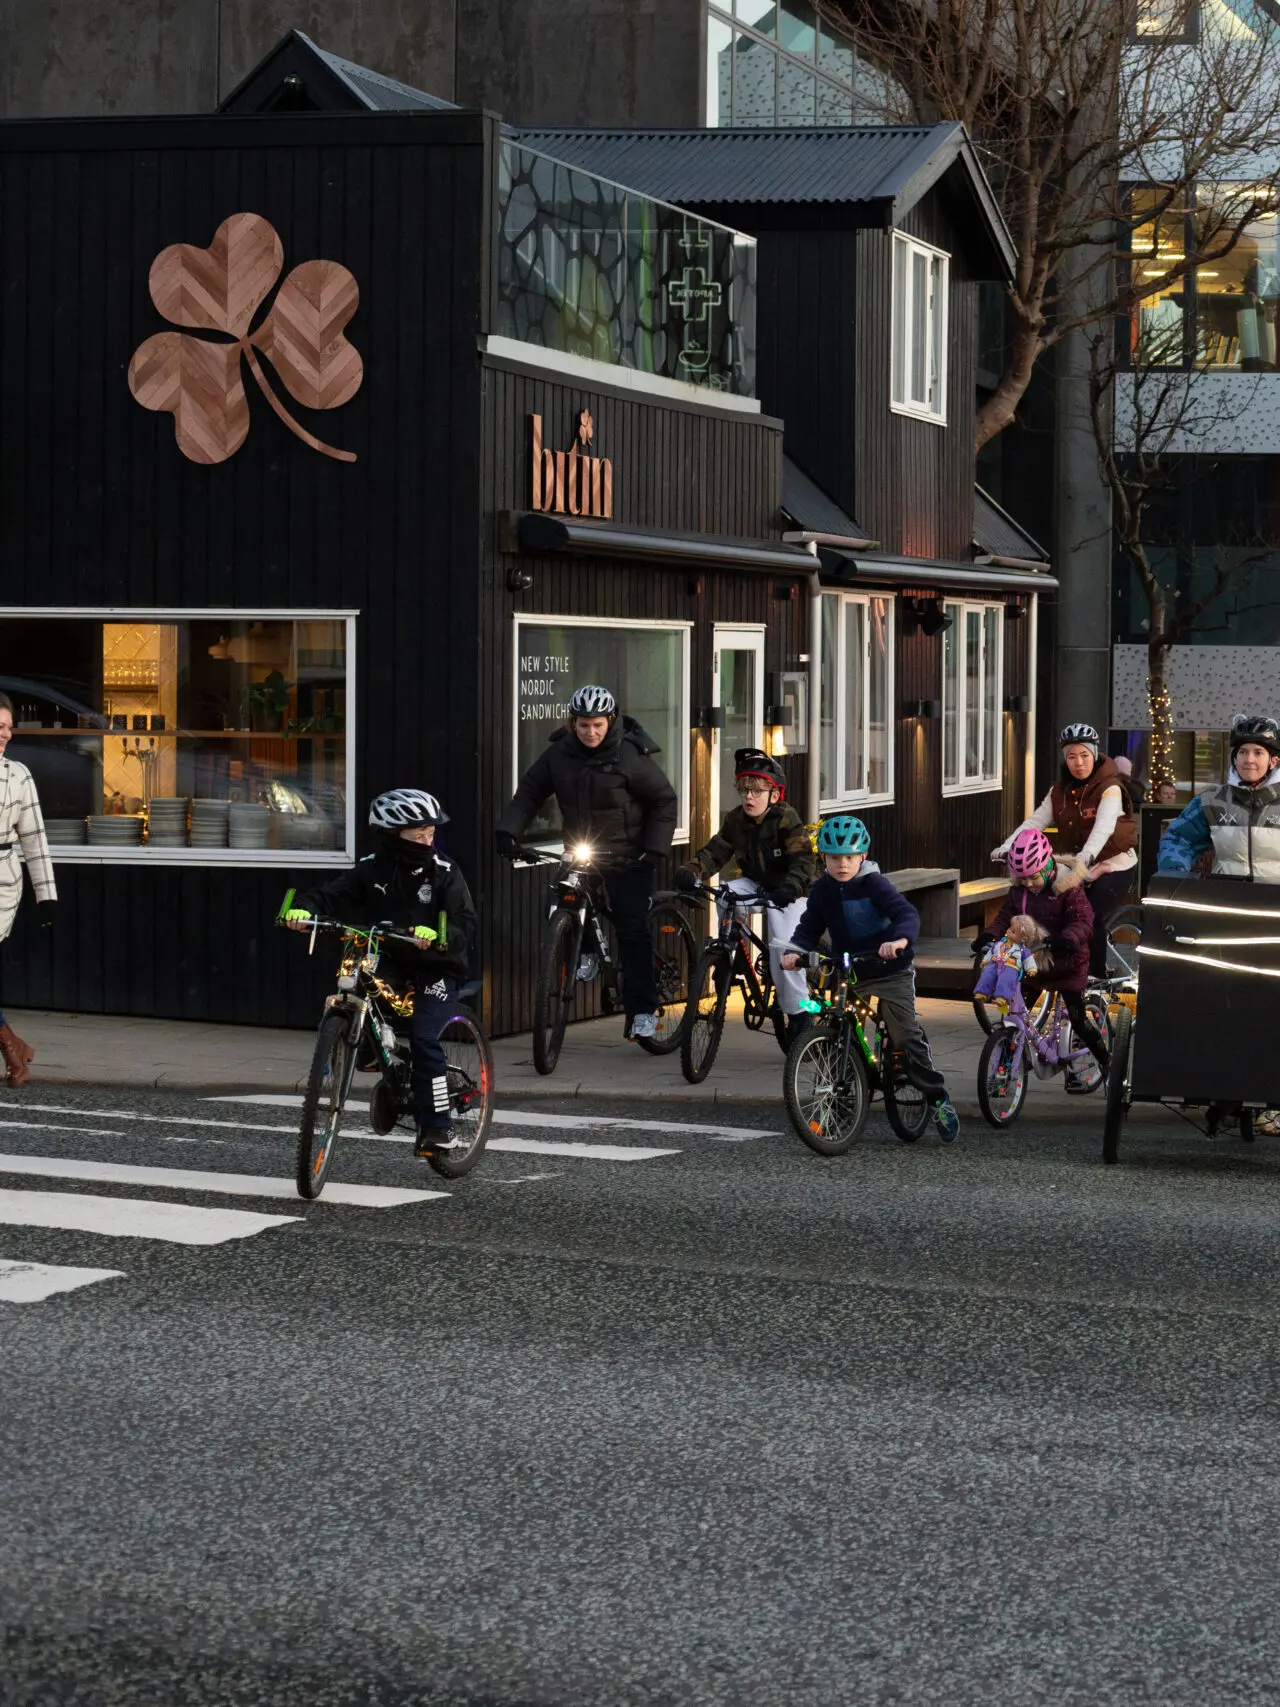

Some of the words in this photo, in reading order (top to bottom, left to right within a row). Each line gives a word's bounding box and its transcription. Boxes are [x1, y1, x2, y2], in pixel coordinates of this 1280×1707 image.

[521, 656, 541, 673] NEW
[544, 656, 569, 673] STYLE
[521, 679, 554, 696] NORDIC
[521, 703, 571, 720] SANDWICHE
